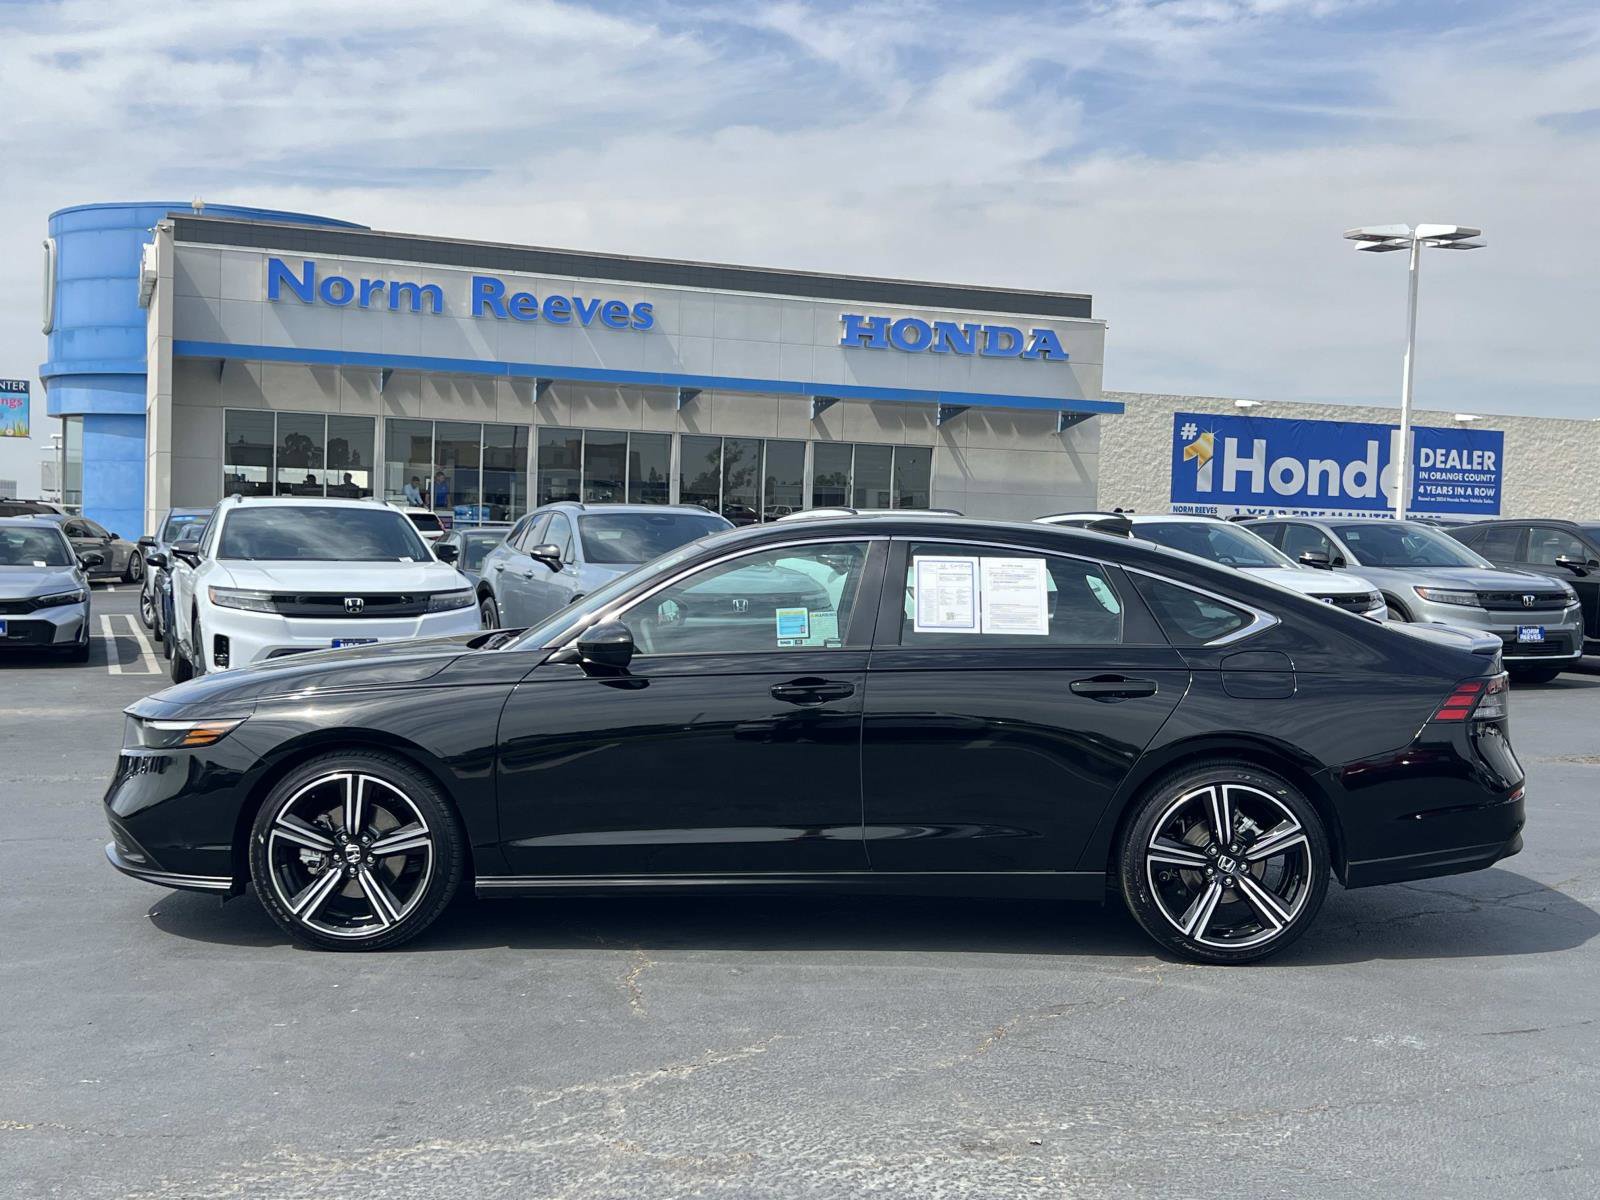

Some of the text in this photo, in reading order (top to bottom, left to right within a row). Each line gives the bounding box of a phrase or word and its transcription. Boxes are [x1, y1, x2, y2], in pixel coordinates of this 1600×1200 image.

[267, 257, 655, 331] Norm Reeves
[839, 313, 1069, 361] HONDA
[1420, 447, 1496, 471] DEALER
[1419, 471, 1496, 482] IN ORANGE COUNTY
[1418, 485, 1496, 497] 4 YEARS IN A ROW
[1172, 505, 1218, 515] NORM REEVES
